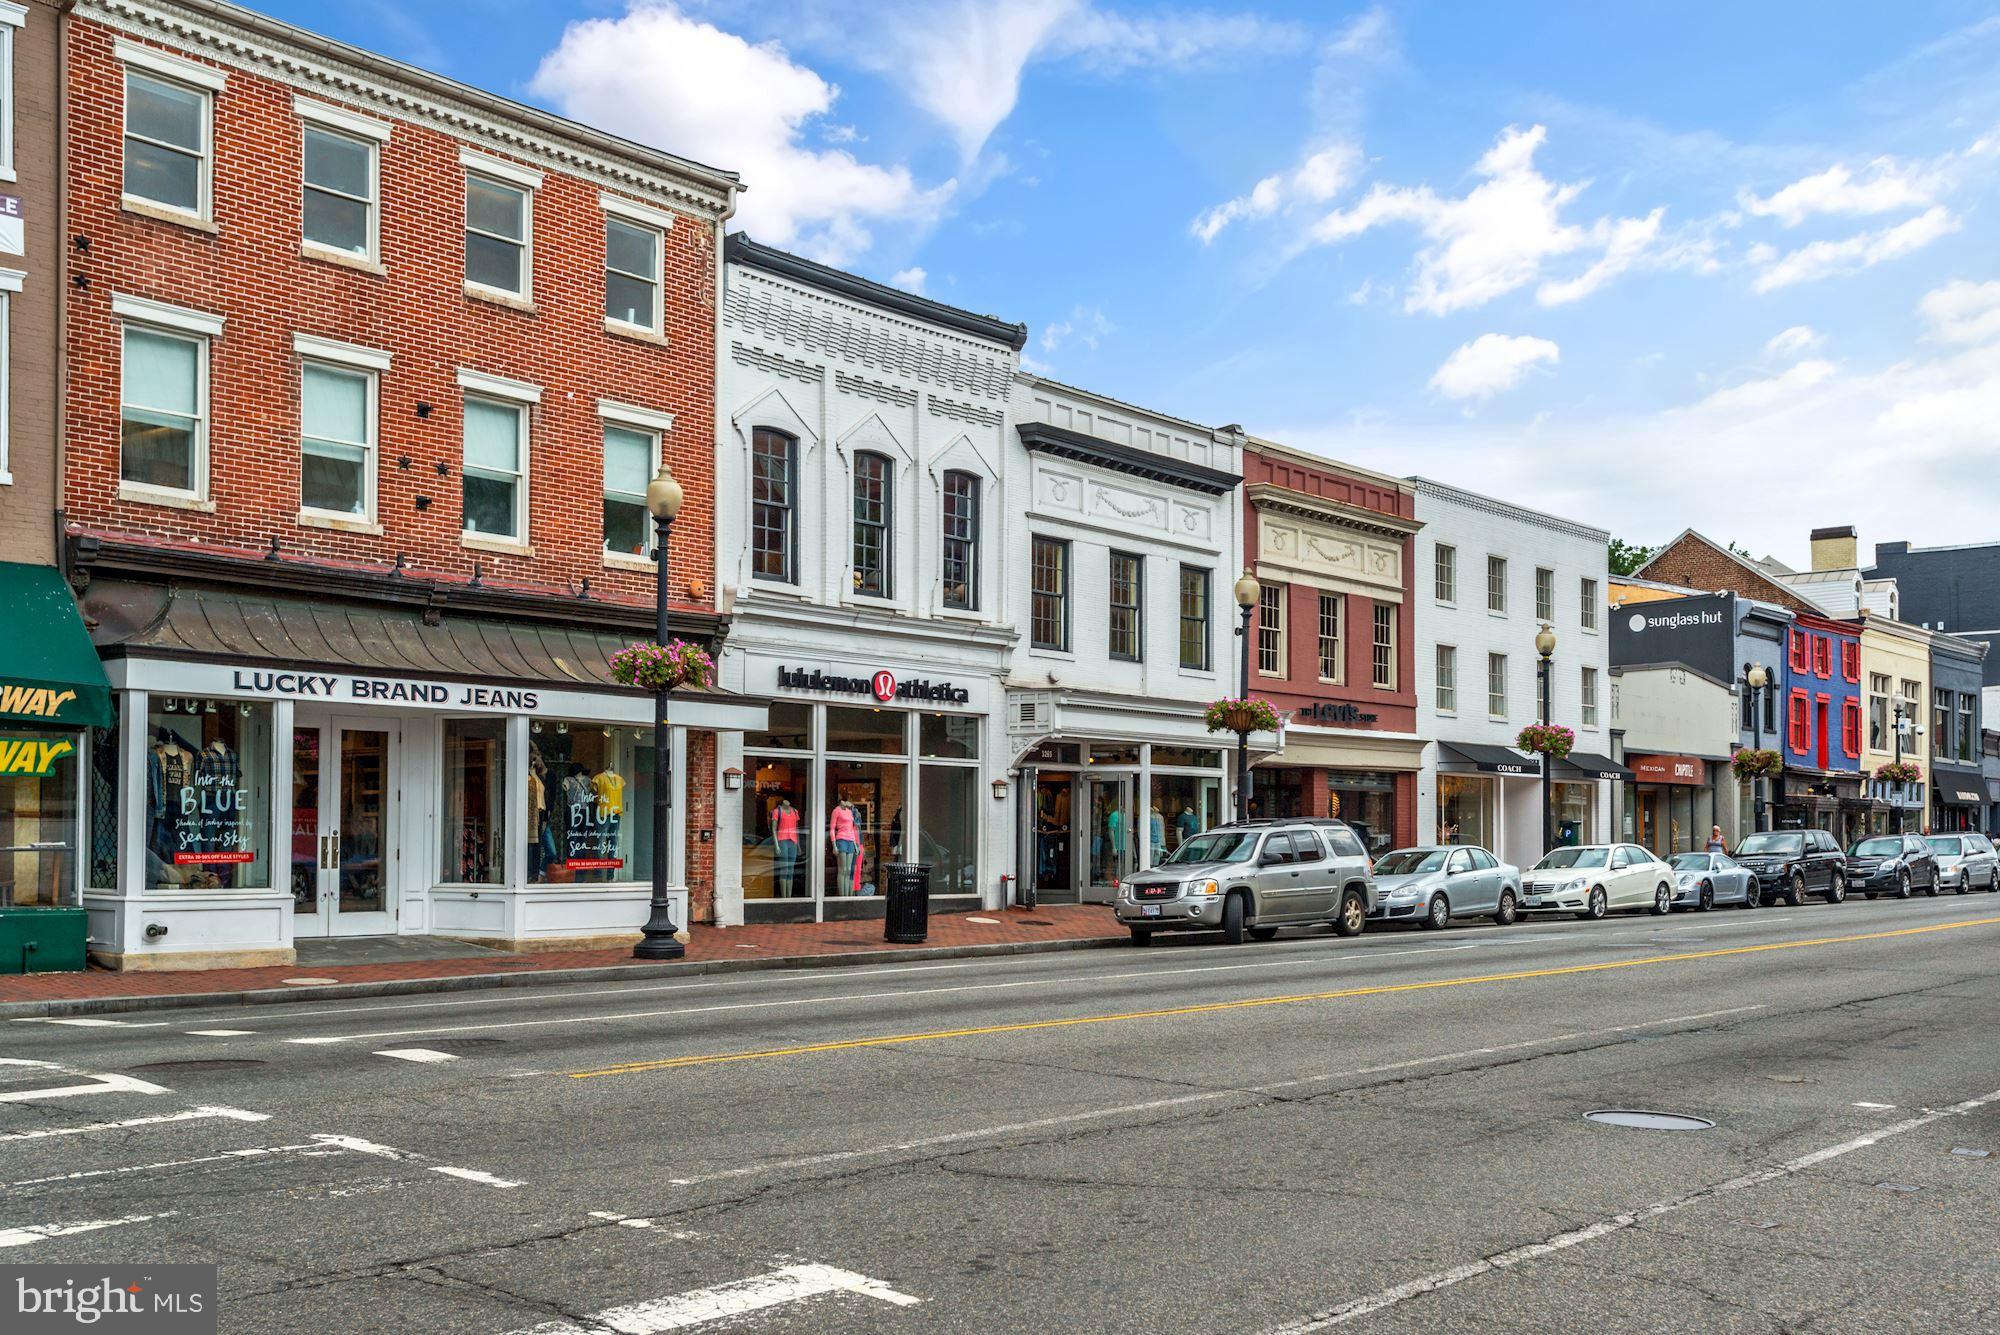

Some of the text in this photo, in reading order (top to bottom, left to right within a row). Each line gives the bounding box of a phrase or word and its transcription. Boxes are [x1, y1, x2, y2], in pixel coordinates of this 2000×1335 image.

[1648, 610, 1722, 629] sunglass hut
[233, 670, 539, 709] LUCKY BRAND JEANS
[777, 665, 969, 703] lululemon athletica
[0, 685, 77, 717] WAY
[194, 769, 218, 787] Into
[219, 774, 235, 787] the
[1497, 764, 1521, 772] COACH
[1600, 771, 1620, 779] COACH
[180, 786, 248, 815] BLUE
[570, 803, 619, 828] BLUE
